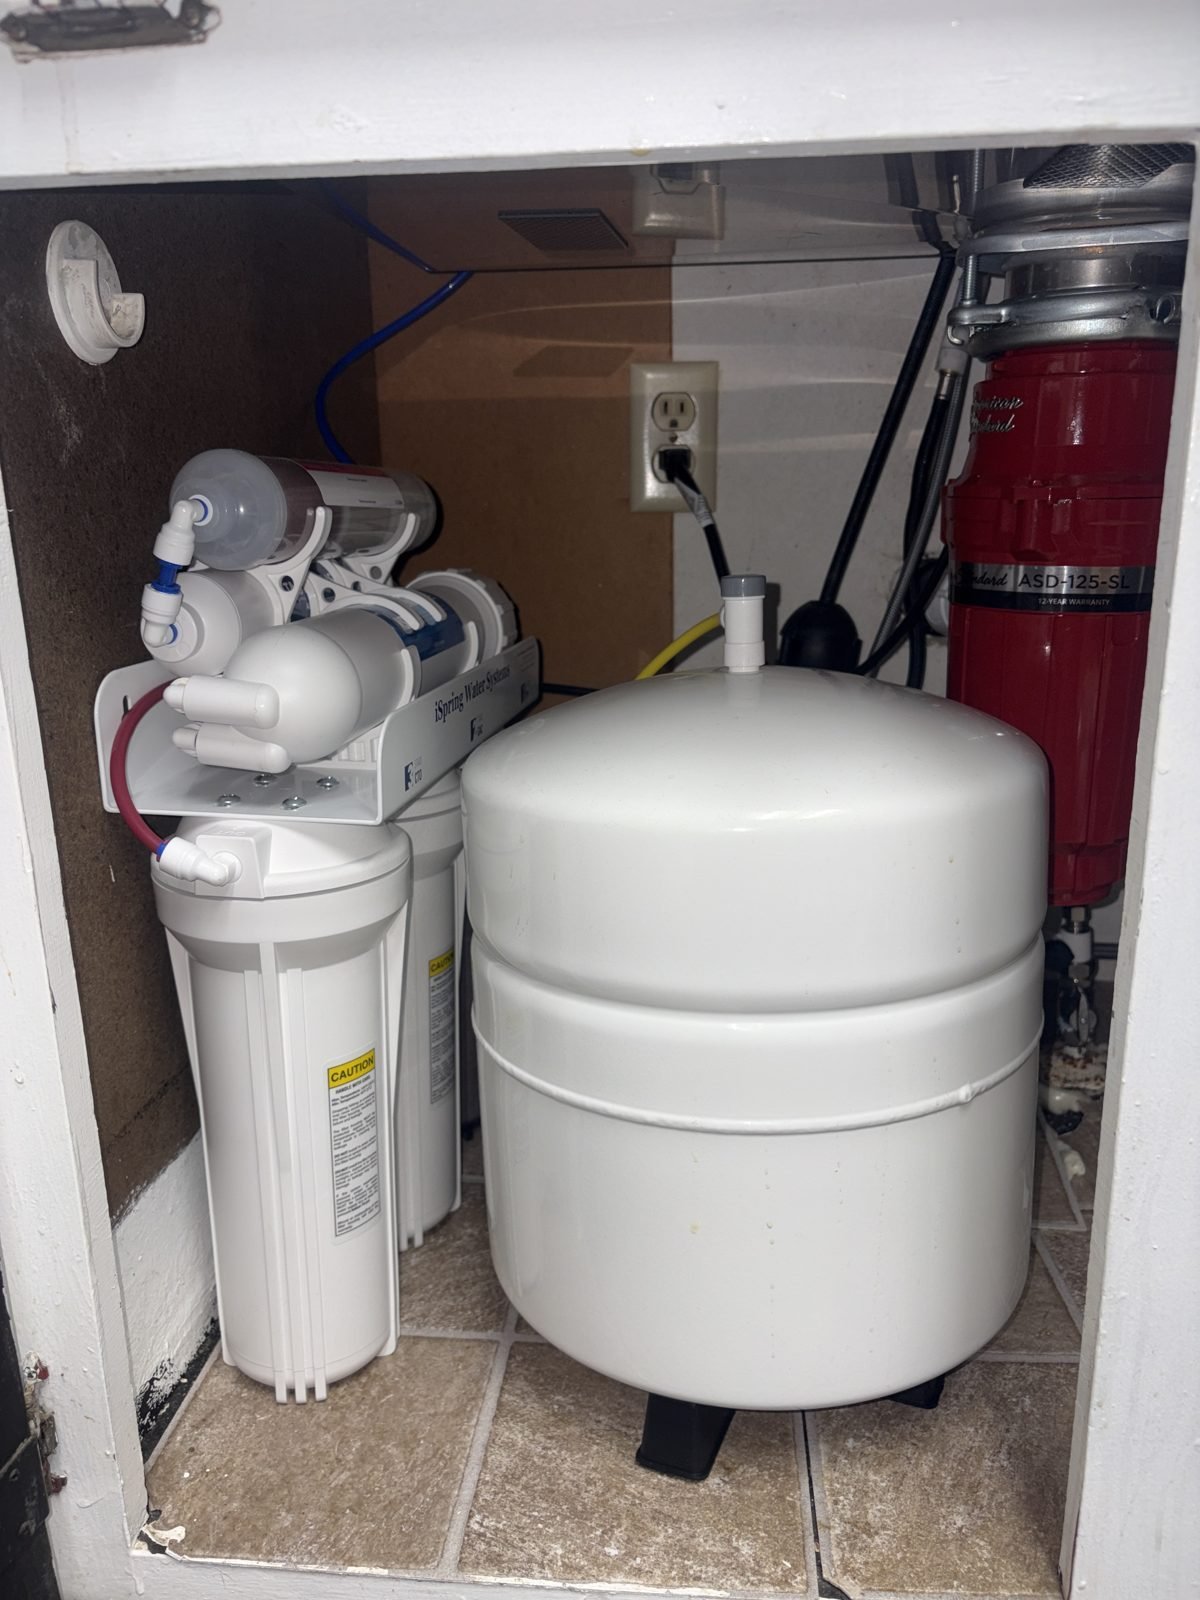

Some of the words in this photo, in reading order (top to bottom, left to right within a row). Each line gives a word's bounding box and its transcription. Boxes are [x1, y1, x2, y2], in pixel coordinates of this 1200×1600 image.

[1018, 574, 1130, 589] ASD-125-SL
[1069, 598, 1110, 606] WARRANTY
[435, 691, 464, 723] iSpring
[464, 680, 486, 702] Water
[486, 665, 510, 693] Systems
[330, 1055, 374, 1083] CAUTION
